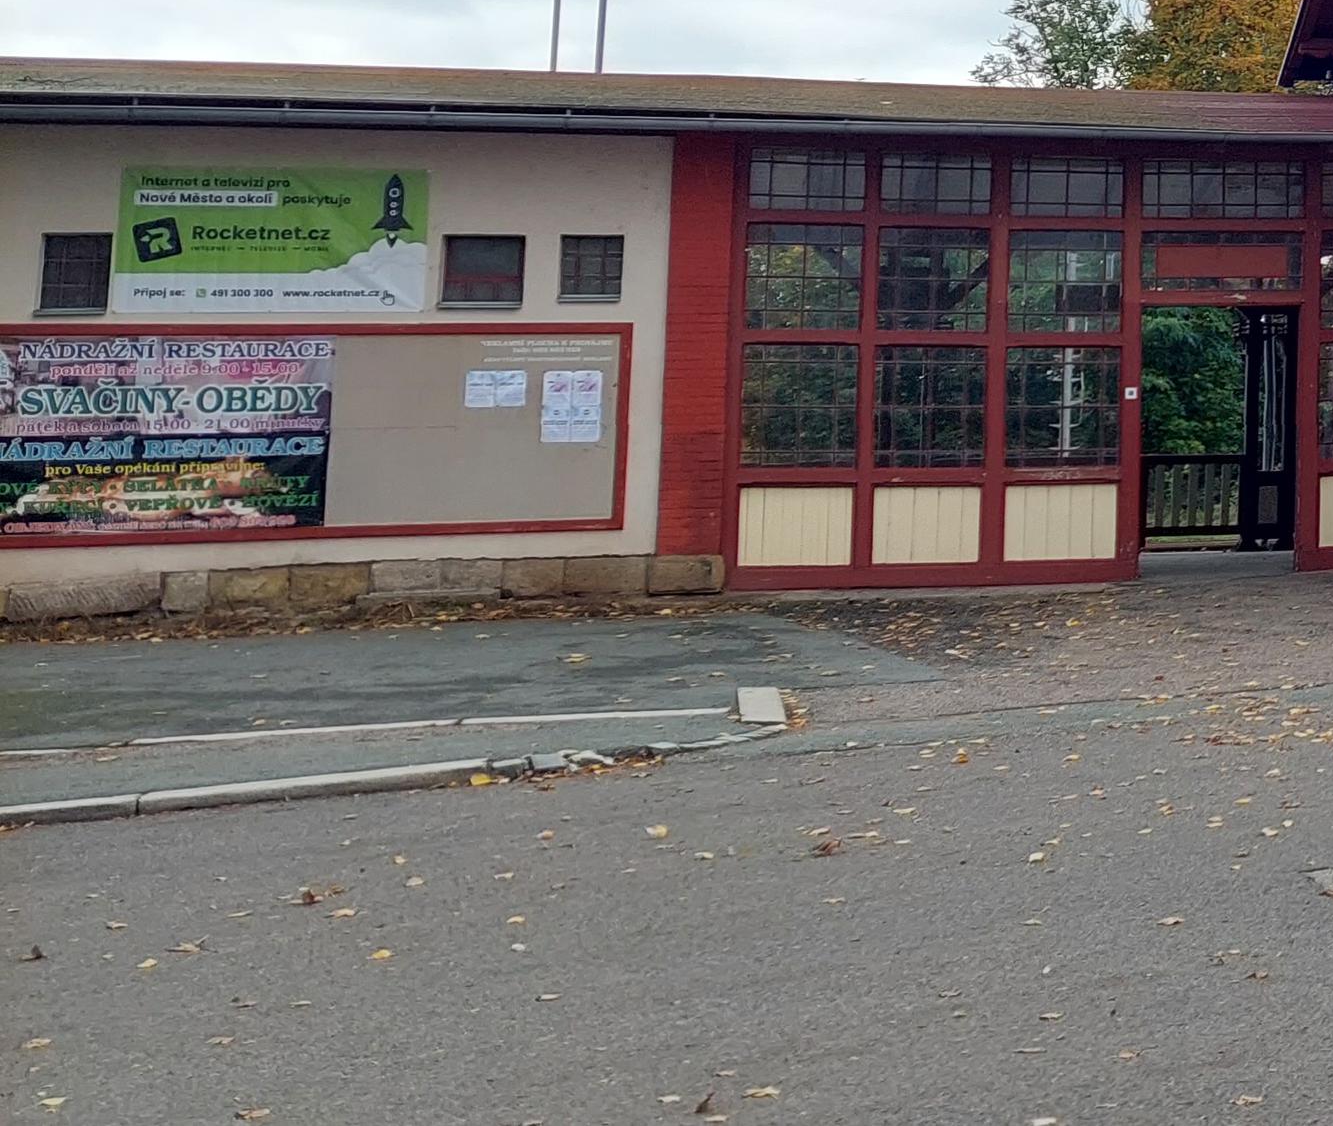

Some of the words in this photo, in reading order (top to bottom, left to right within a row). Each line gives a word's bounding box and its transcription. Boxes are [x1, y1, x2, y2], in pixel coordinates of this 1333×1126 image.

[141, 176, 198, 187] Internet
[201, 178, 210, 187] a
[267, 179, 290, 191] pro
[140, 192, 176, 203] Nové
[180, 192, 223, 203] Město
[226, 195, 235, 203] a
[238, 193, 273, 203] okolí
[282, 195, 351, 208] poskytuje
[192, 225, 331, 240] Rocketnet.cz
[133, 287, 167, 299] Připoj
[169, 289, 186, 297] se:
[210, 289, 228, 297] 491
[230, 289, 251, 297] 300
[253, 289, 273, 297] 300
[21, 339, 155, 360] NÁDRAŽNÍ
[50, 362, 115, 379] pondělí
[143, 362, 198, 375] neděle
[16, 418, 65, 435] pátek
[82, 419, 138, 432] sobota
[142, 436, 326, 459] RESTAURACE
[45, 462, 72, 478] pro
[76, 463, 113, 474] Vaše
[115, 462, 176, 476] opékání
